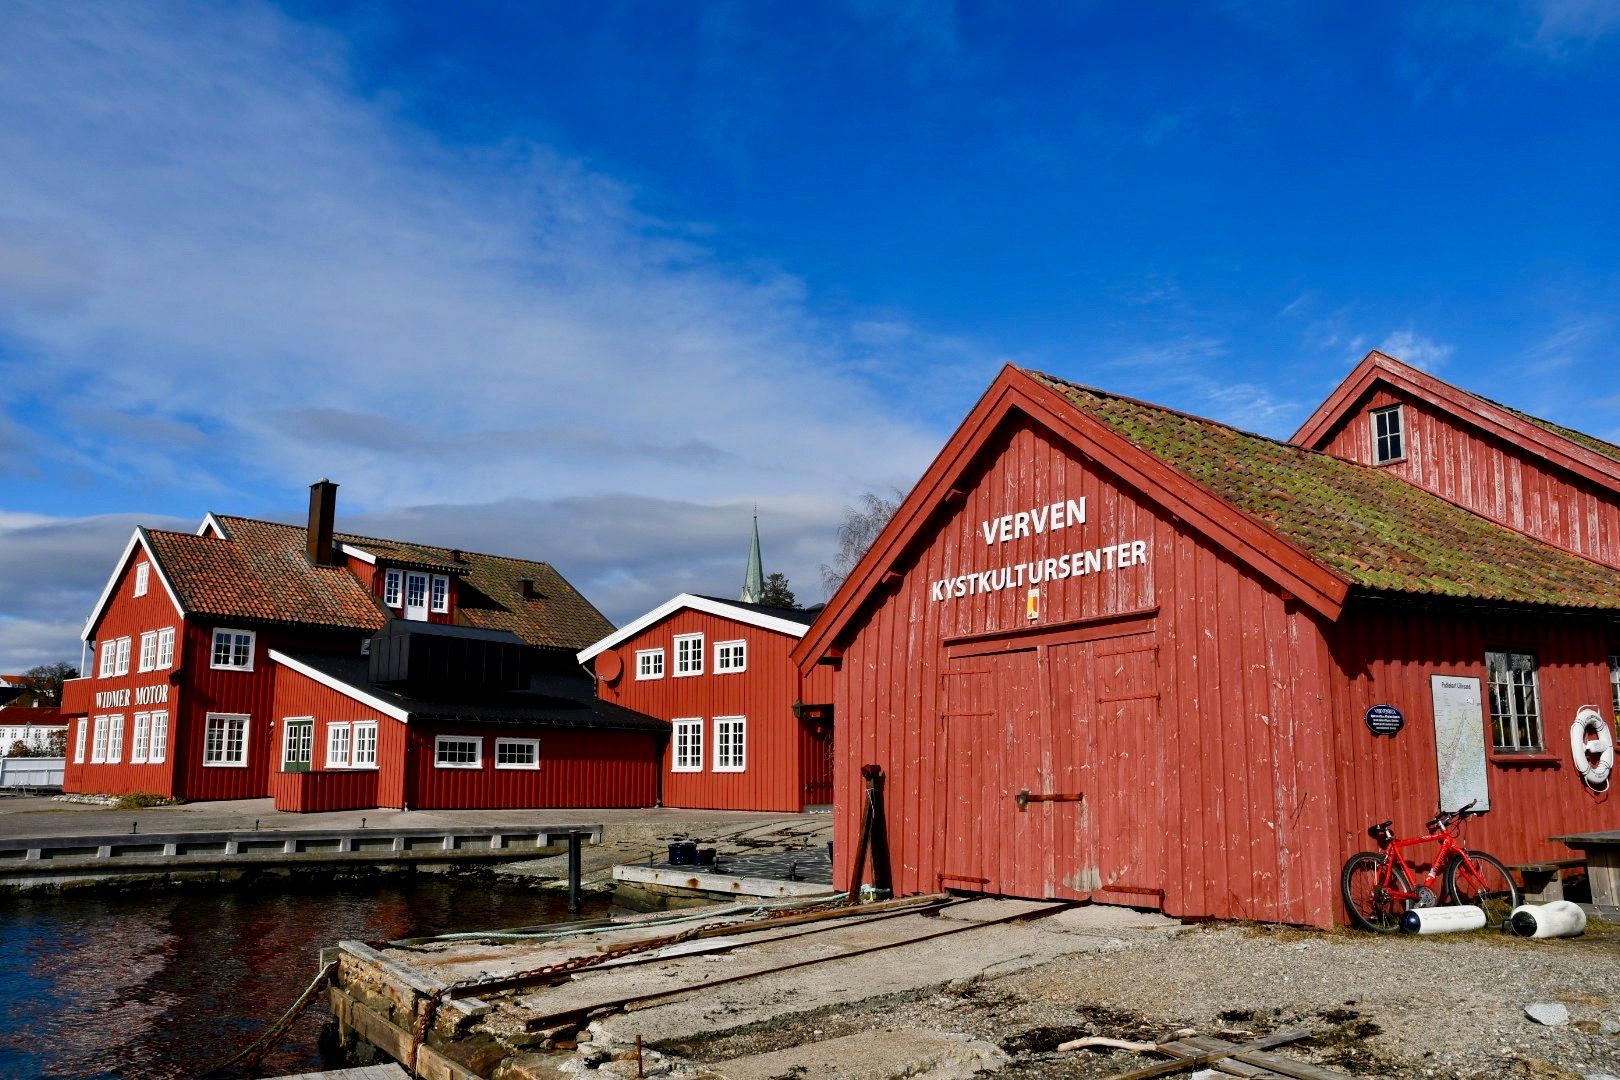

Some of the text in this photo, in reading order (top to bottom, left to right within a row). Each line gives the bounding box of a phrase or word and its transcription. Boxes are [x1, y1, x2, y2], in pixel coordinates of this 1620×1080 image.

[983, 496, 1087, 545] VERVEN
[931, 540, 1147, 602] KYSTKULTURSENTER
[96, 684, 169, 709] WIDMER MOTOR
